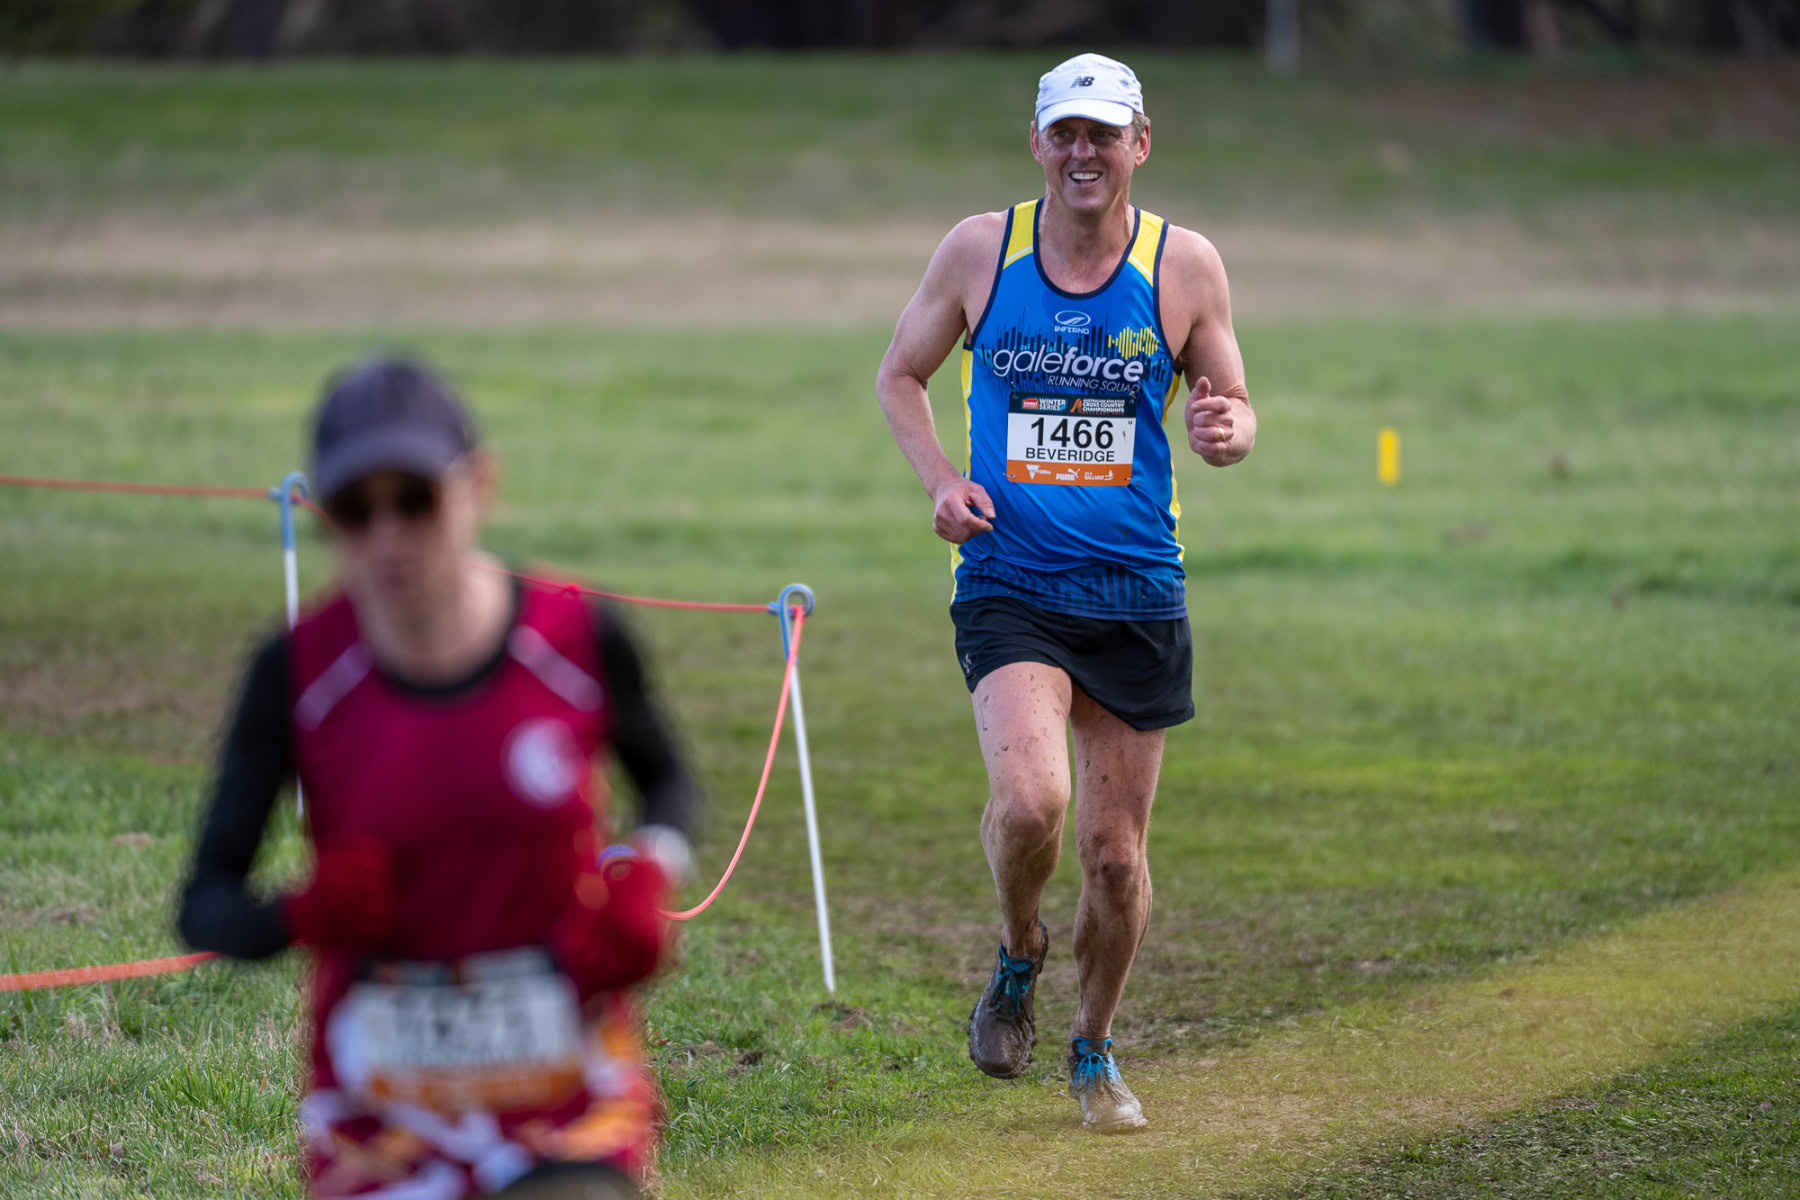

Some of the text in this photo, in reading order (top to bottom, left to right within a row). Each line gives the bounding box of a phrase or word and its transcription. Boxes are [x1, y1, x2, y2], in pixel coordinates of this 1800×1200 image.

[1070, 76, 1095, 88] NB
[1054, 326, 1089, 334] INFERNO
[993, 344, 1144, 382] galeforce
[1048, 375, 1140, 393] RUNNING SQUAD
[1039, 398, 1066, 406] WINTER
[1031, 417, 1114, 449] 1466
[1026, 447, 1115, 462] BEVERIDGE
[1055, 473, 1075, 481] PUMA
